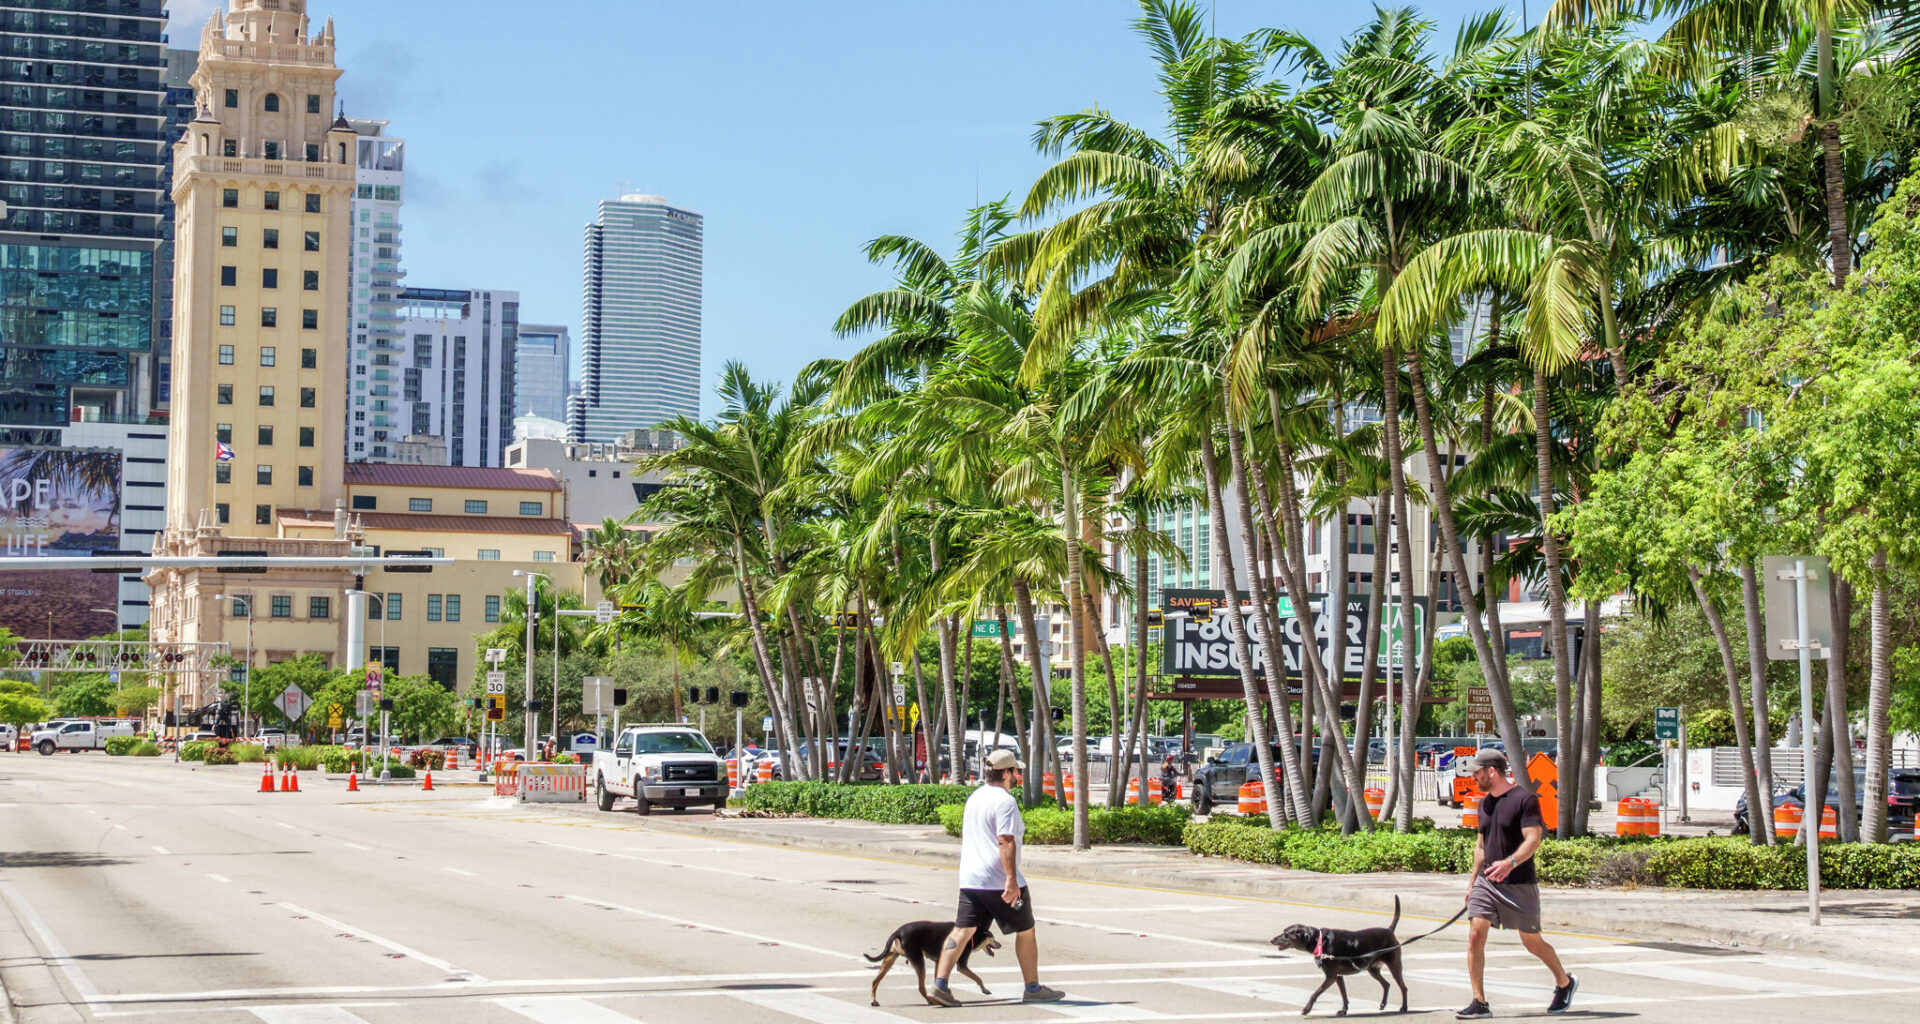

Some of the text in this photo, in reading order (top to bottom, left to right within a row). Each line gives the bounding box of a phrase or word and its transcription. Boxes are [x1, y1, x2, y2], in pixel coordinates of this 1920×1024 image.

[7, 533, 49, 557] LIFE
[975, 624, 996, 633] NE 8
[489, 684, 502, 692] 30
